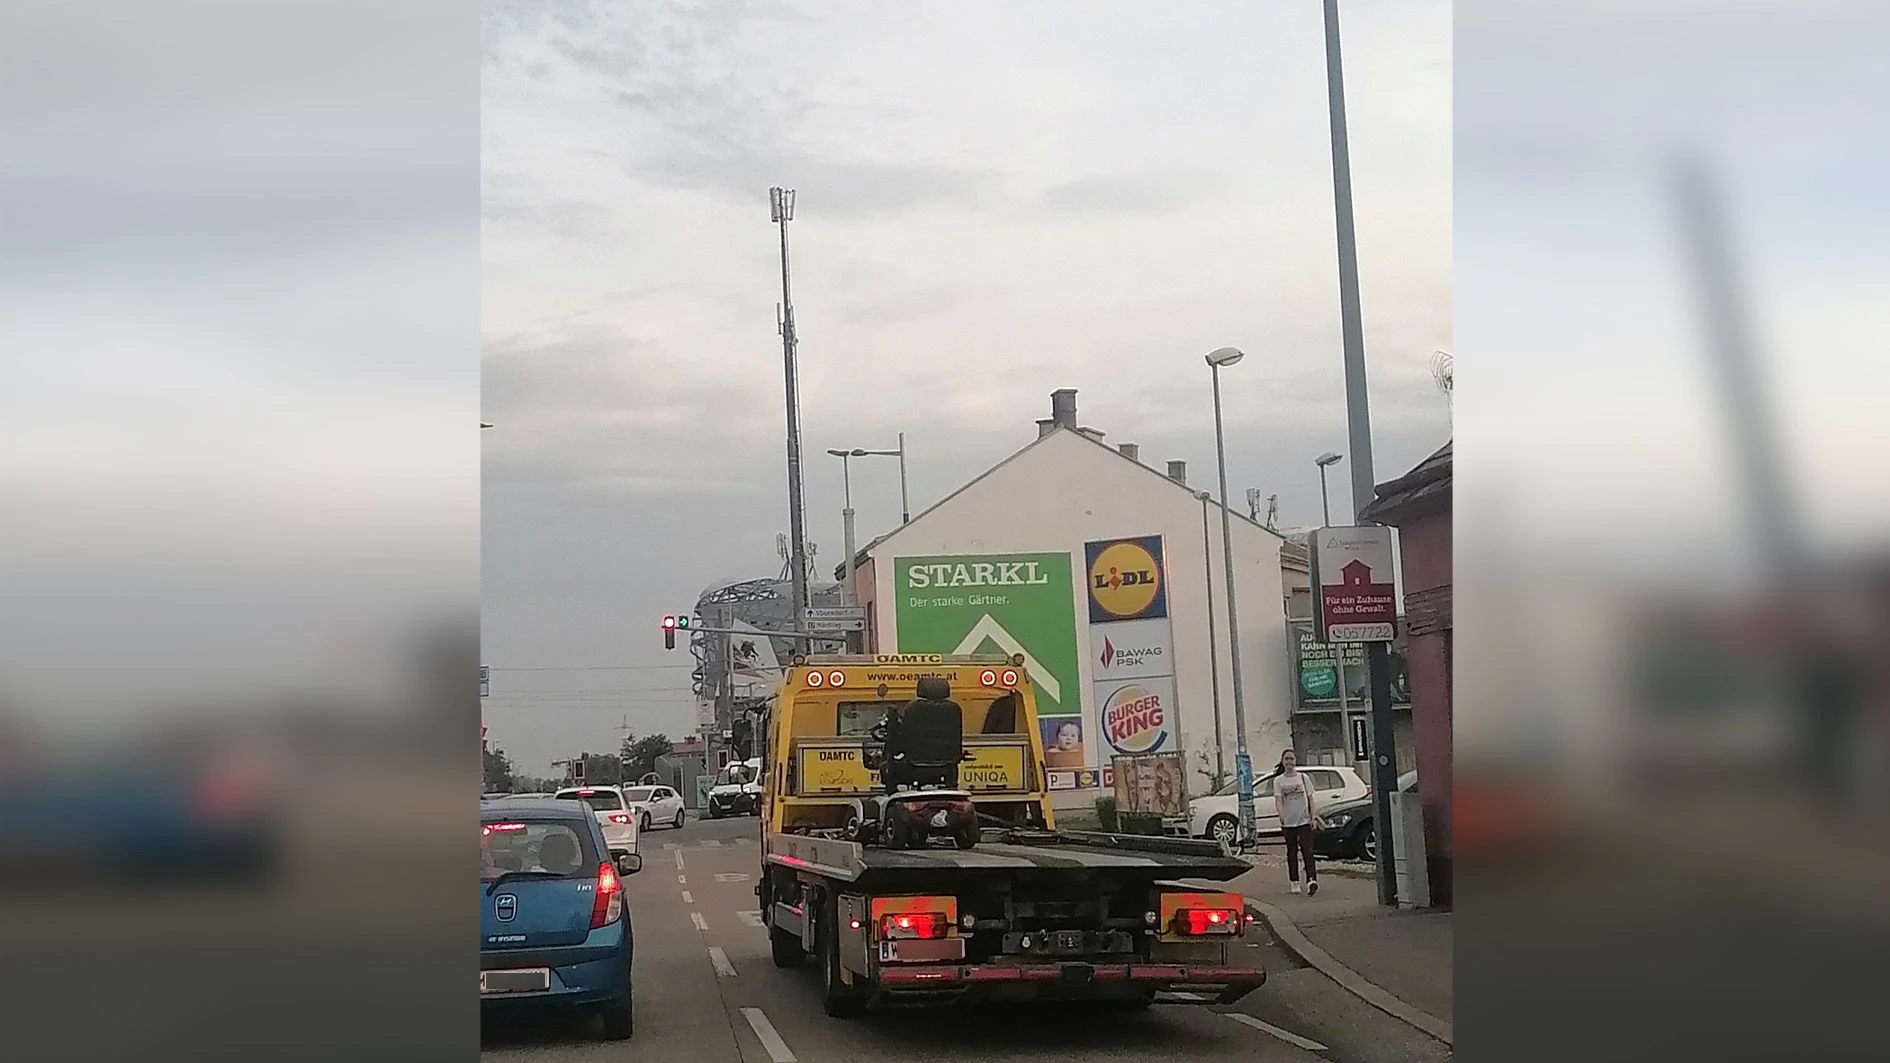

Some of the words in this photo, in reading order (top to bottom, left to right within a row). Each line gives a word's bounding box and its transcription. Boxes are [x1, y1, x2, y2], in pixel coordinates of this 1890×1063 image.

[908, 562, 1048, 588] STARKL
[1095, 566, 1154, 590] LIDL
[910, 597, 928, 608] Der
[932, 595, 964, 607] starke
[968, 594, 1010, 606] Gärtner.
[1341, 595, 1355, 604] ein
[1343, 626, 1391, 639] 057722
[876, 654, 941, 663] ÖAMTC
[1116, 647, 1162, 658] BAWAG
[1116, 658, 1144, 667] PSK
[1108, 695, 1161, 726] BURGER
[1111, 708, 1164, 744] KING
[963, 771, 1008, 782] UNIQA
